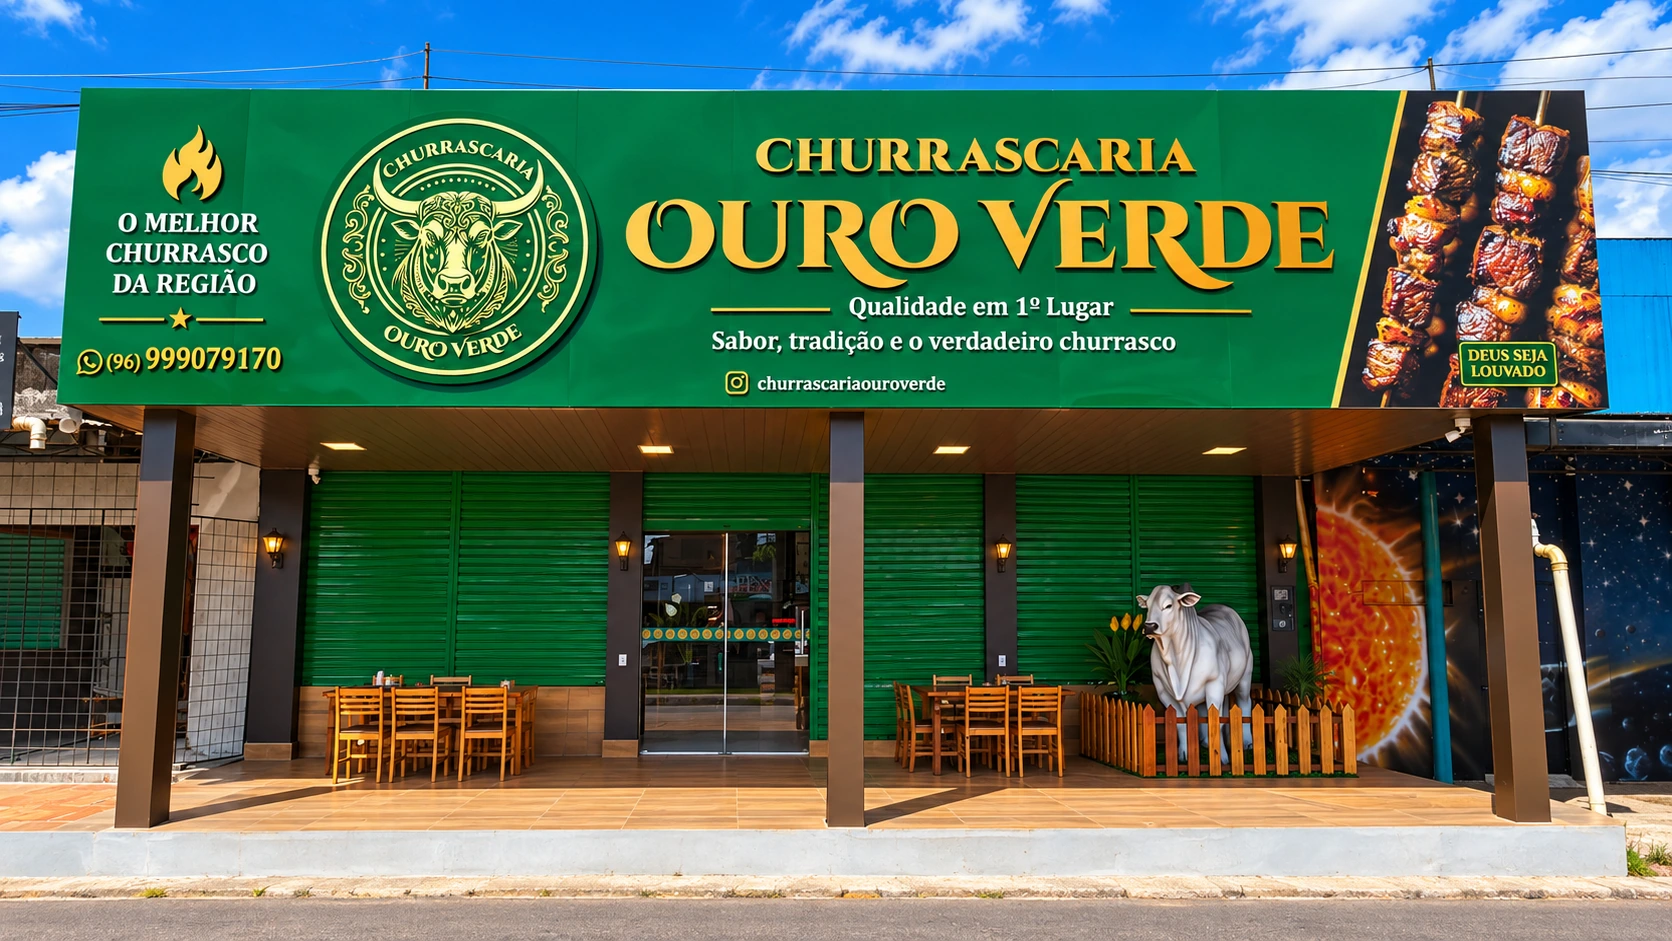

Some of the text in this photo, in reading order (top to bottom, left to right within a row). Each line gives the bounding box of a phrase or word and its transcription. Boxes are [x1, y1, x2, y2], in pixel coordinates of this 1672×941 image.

[383, 140, 534, 181] CHURRASCARIA
[756, 137, 1197, 173] CHURRASCARIA
[118, 212, 259, 234] O MELHOR
[625, 178, 1335, 290] OURO VERDE
[105, 242, 268, 265] CHURRASCO
[112, 268, 256, 295] DA REGIÃO
[849, 295, 967, 321] Qualidade
[972, 301, 1009, 317] em
[1046, 296, 1115, 323] Lugar
[384, 323, 523, 361] OURO VERDE
[712, 330, 1176, 356] Sabor, tradição e o verdadeiro churrasco
[106, 346, 281, 375] (96) 999079170
[1468, 349, 1549, 364] DEUS SEJA
[757, 375, 946, 392] churrascariaouroverde
[1471, 365, 1546, 378] LOUVADO
